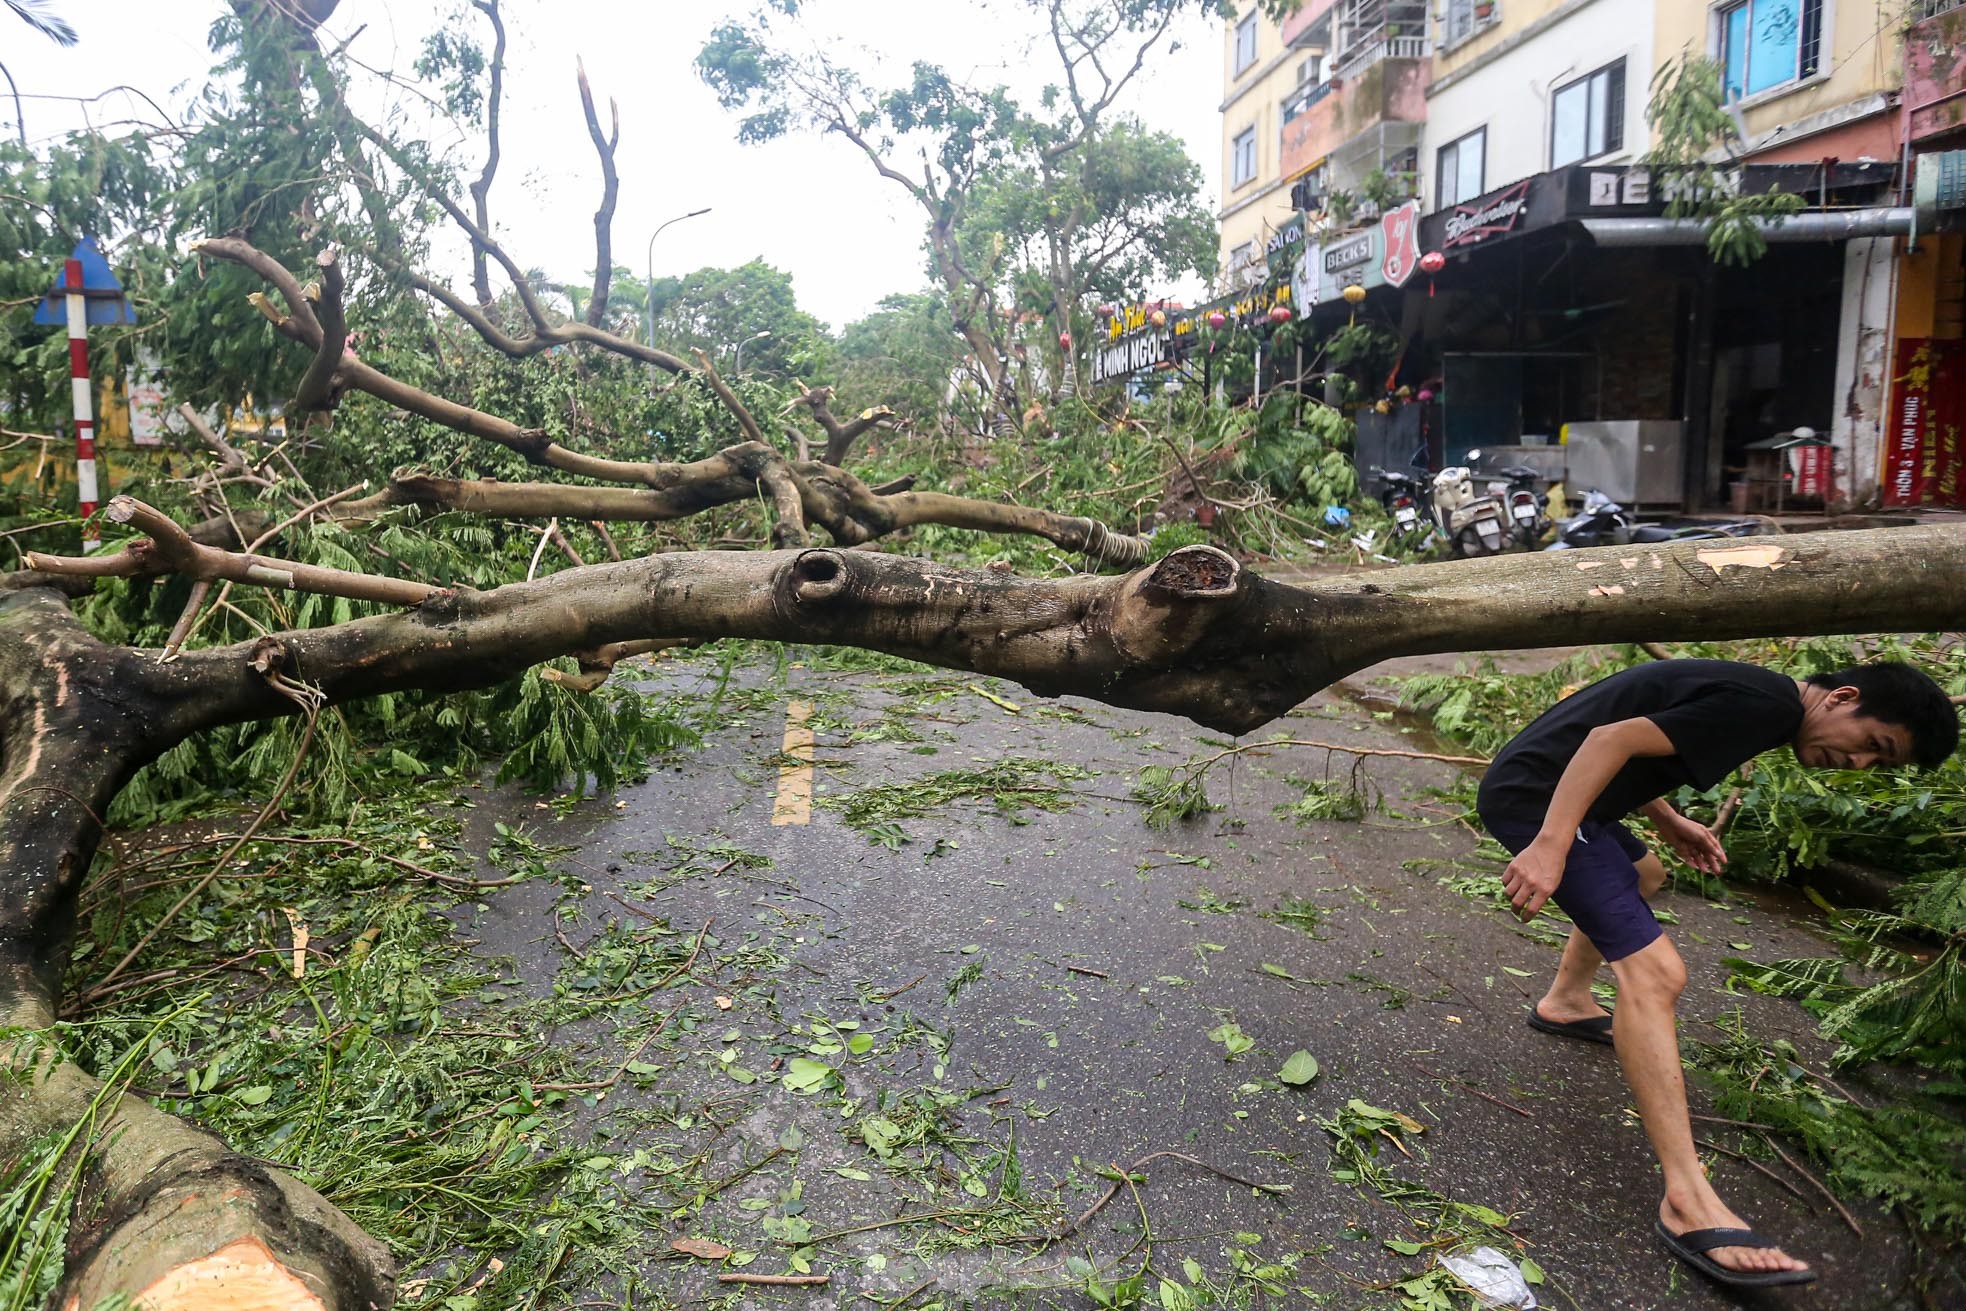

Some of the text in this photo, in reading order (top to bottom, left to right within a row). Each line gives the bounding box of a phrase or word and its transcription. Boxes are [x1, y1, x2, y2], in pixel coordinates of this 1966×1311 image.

[1104, 343, 1129, 378] MINH
[1901, 428, 1919, 450] VẠN
[1899, 459, 1915, 468] 3
[1896, 470, 1913, 497] THÔN
